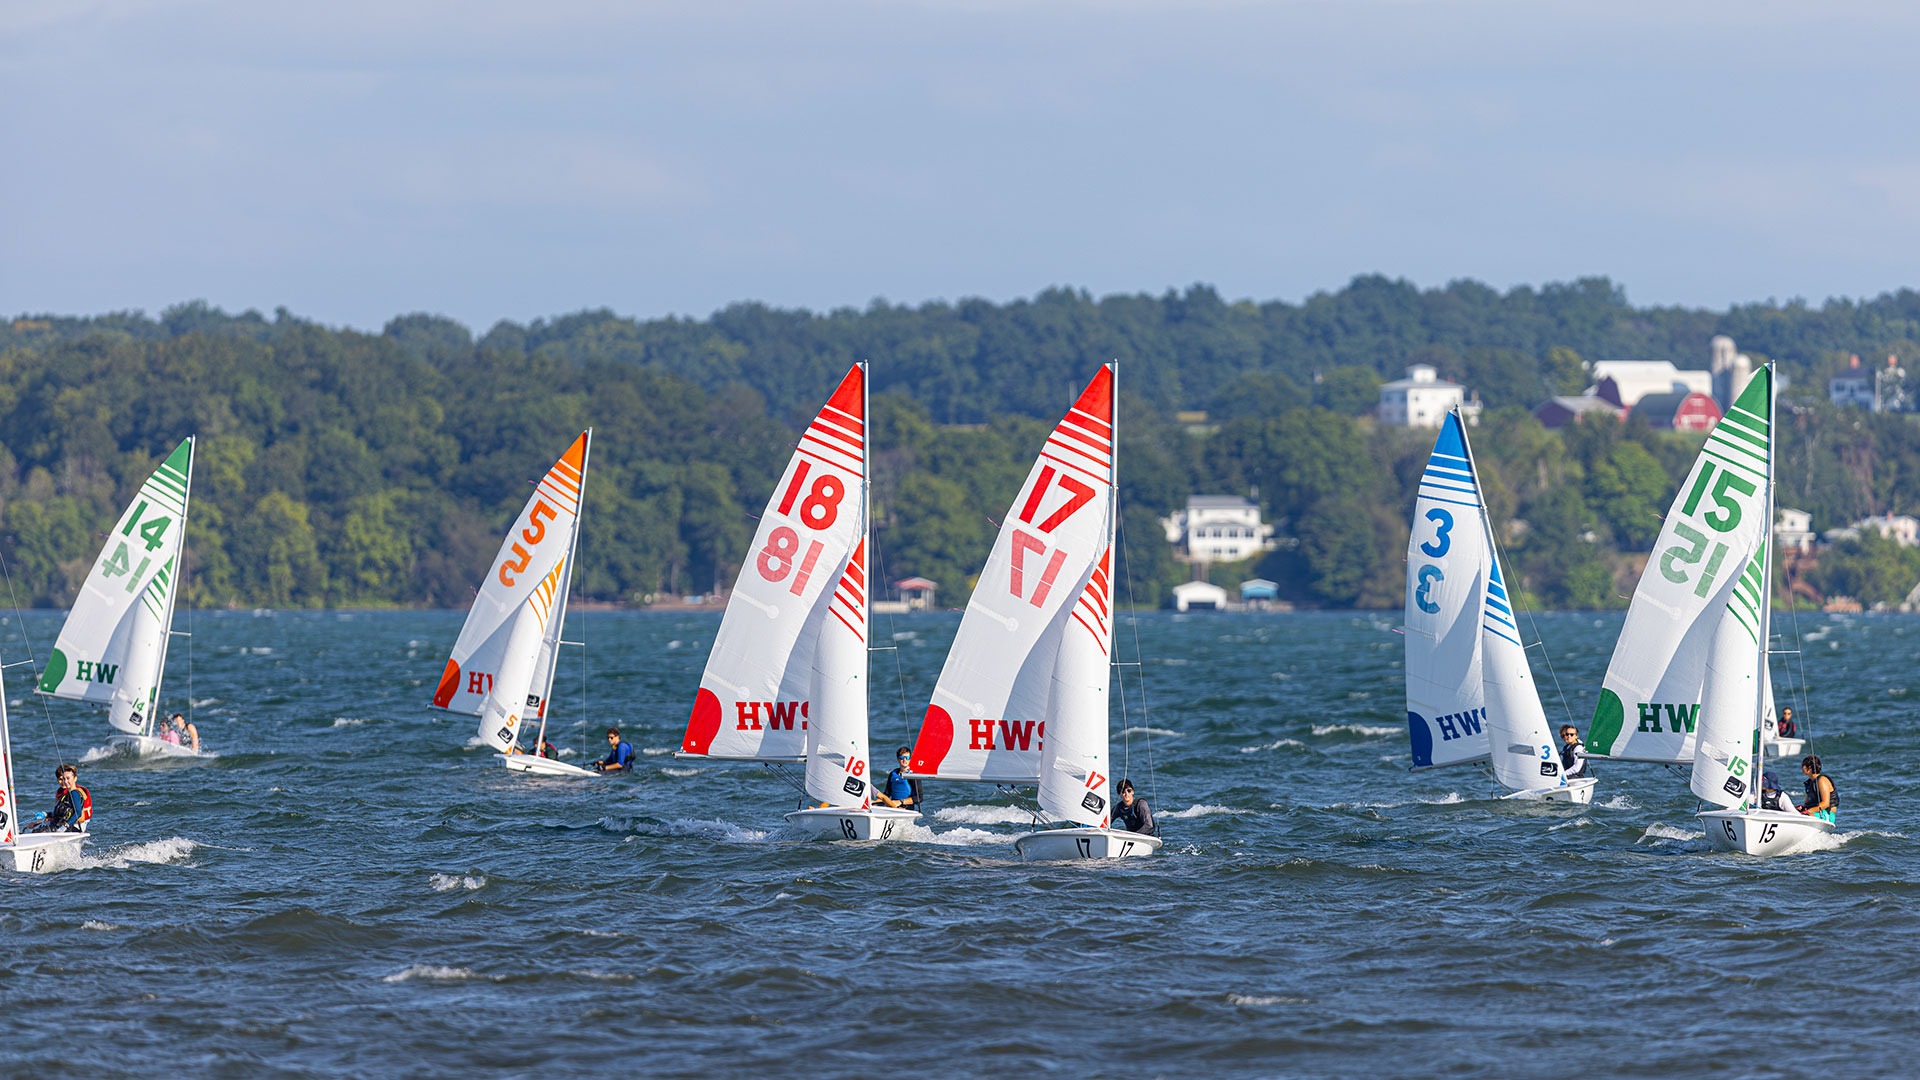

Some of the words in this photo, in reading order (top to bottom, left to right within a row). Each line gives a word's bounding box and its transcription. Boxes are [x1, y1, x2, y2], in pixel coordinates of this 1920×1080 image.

[778, 459, 845, 531] 18
[1019, 464, 1096, 534] 17
[1681, 459, 1757, 533] 15
[121, 500, 172, 552] 14
[522, 499, 558, 545] 5
[1420, 507, 1454, 558] 3
[76, 660, 121, 684] HW
[131, 697, 145, 712] 14
[506, 714, 519, 728] 5
[1435, 706, 1486, 741] HW
[1541, 744, 1551, 760] 3
[845, 755, 866, 777] 18
[1727, 755, 1748, 777] 15
[1085, 771, 1107, 790] 17
[840, 819, 857, 839] 18
[880, 819, 895, 839] 18
[1722, 820, 1738, 842] 15
[1758, 823, 1779, 844] 15
[1076, 838, 1092, 858] 17
[1119, 841, 1135, 858] 17
[31, 848, 47, 872] 16
